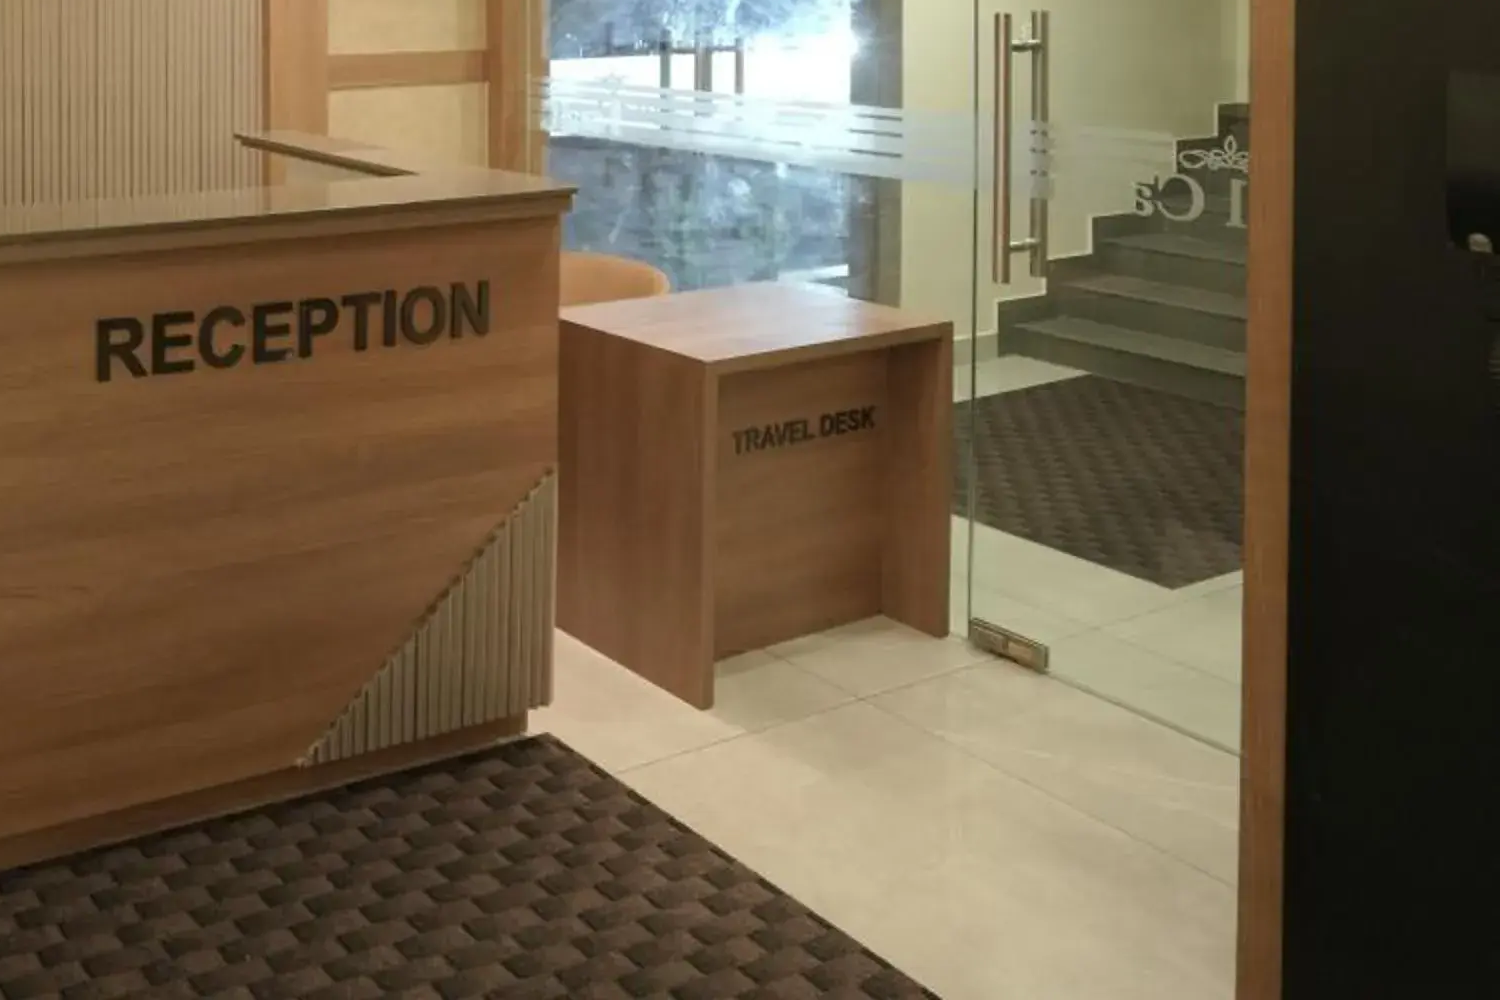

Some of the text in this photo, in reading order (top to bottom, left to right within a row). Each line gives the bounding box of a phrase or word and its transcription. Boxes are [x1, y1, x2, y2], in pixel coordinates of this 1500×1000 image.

[95, 279, 491, 383] RECEPTION
[732, 404, 877, 455] TRAVEL DESK
